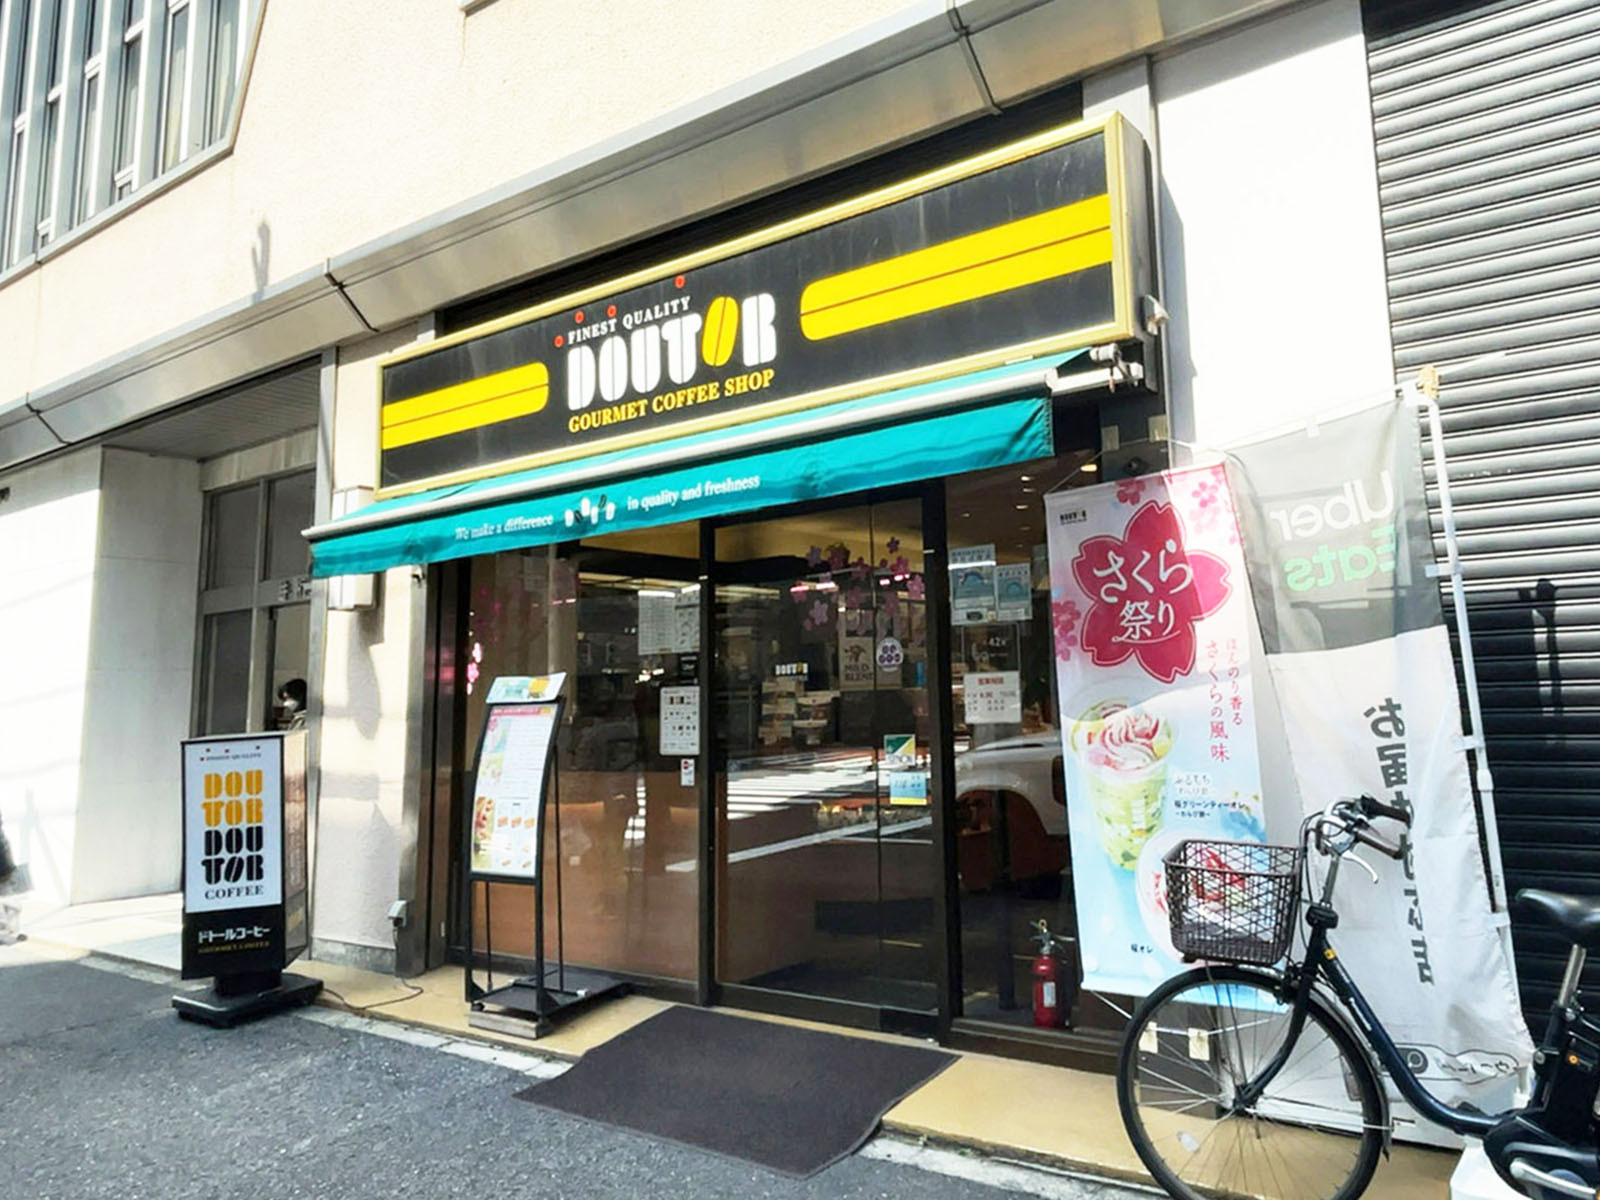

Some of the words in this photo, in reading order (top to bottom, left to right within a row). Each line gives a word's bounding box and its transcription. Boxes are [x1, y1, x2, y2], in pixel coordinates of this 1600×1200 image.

[568, 317, 618, 345] FINEST
[622, 296, 691, 329] QUALITY
[568, 293, 777, 411] DOUTOR
[568, 399, 648, 433] GOURMET
[651, 381, 720, 414] COFFEE
[724, 368, 775, 397] SHOP
[627, 495, 639, 510] in
[641, 489, 680, 512] quality
[681, 483, 702, 501] and
[704, 475, 761, 497] freshness
[503, 514, 554, 533] difference
[1093, 538, 1193, 603] さくら
[1118, 600, 1175, 641] 祭り
[1206, 640, 1230, 762] さくらの風味
[204, 769, 263, 799] DOU
[201, 798, 264, 828] TOR
[204, 826, 264, 856] DOU
[201, 855, 264, 885] TOR
[204, 885, 264, 900] COFFEE
[198, 926, 270, 944] ドトールコーヒー
